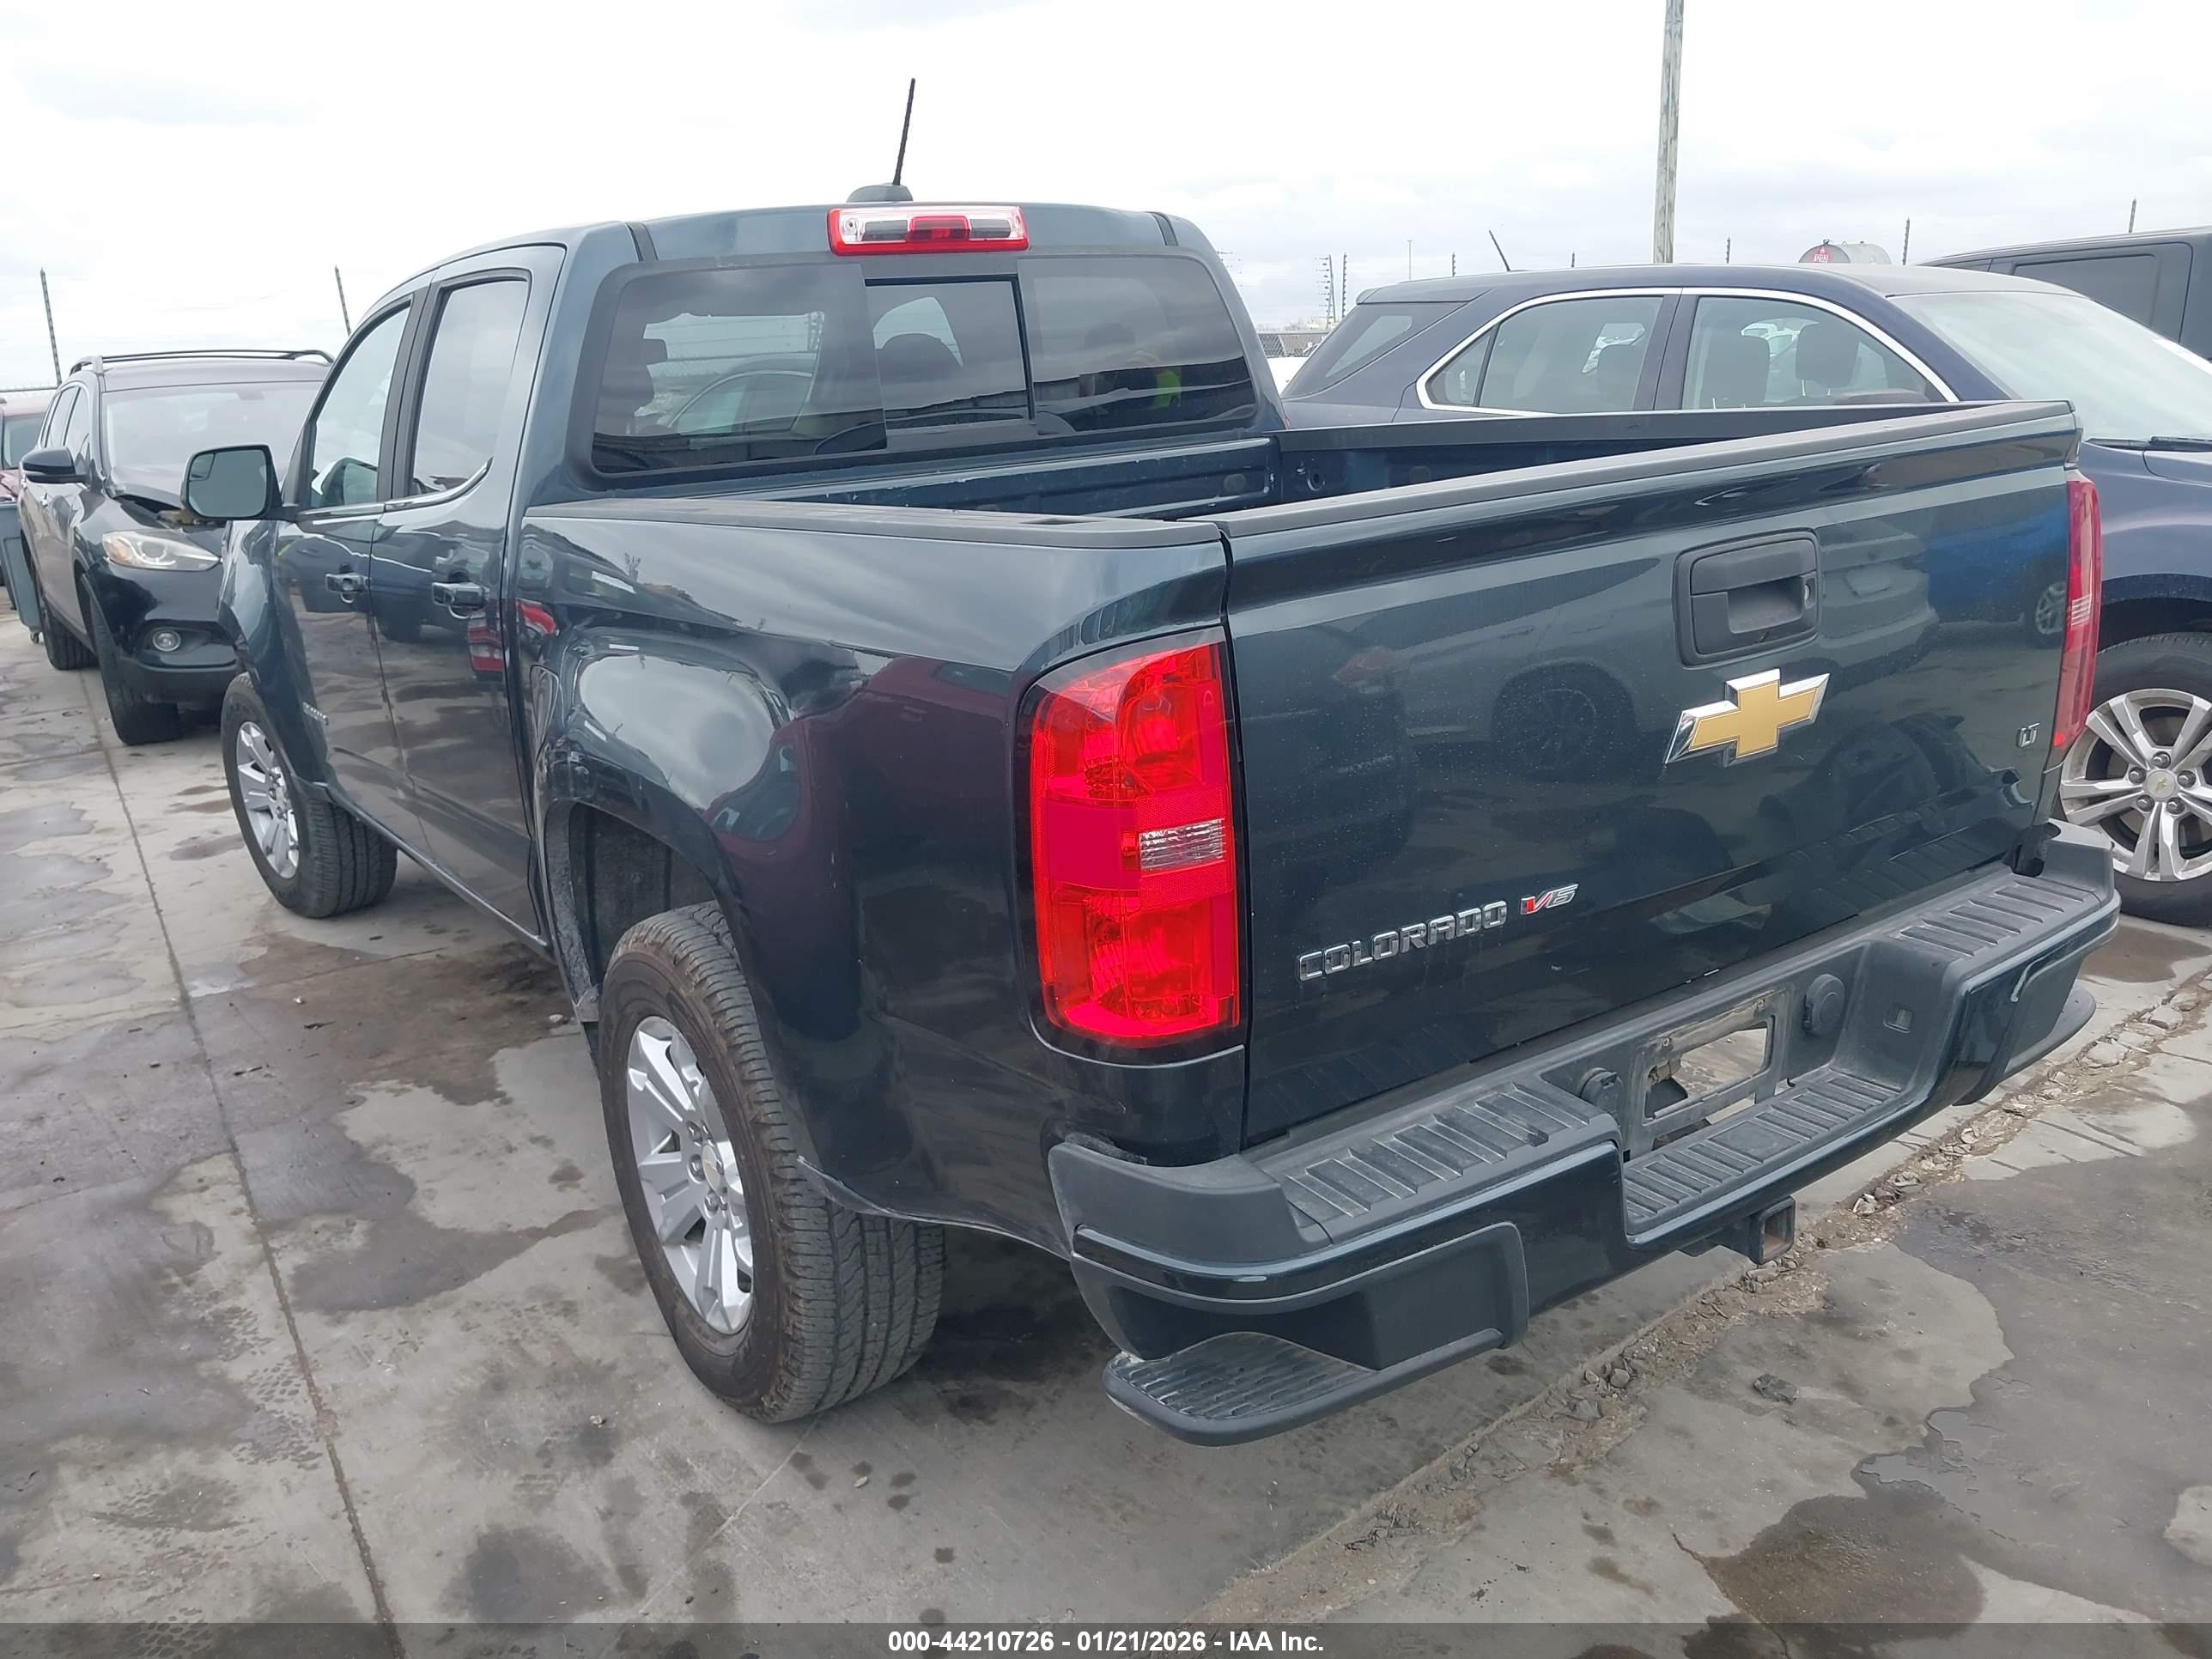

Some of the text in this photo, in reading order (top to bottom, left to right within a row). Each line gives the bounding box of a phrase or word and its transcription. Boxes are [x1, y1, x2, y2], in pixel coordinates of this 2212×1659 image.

[2018, 722, 2041, 748] LT
[1297, 884, 1578, 981] COLORADO V6
